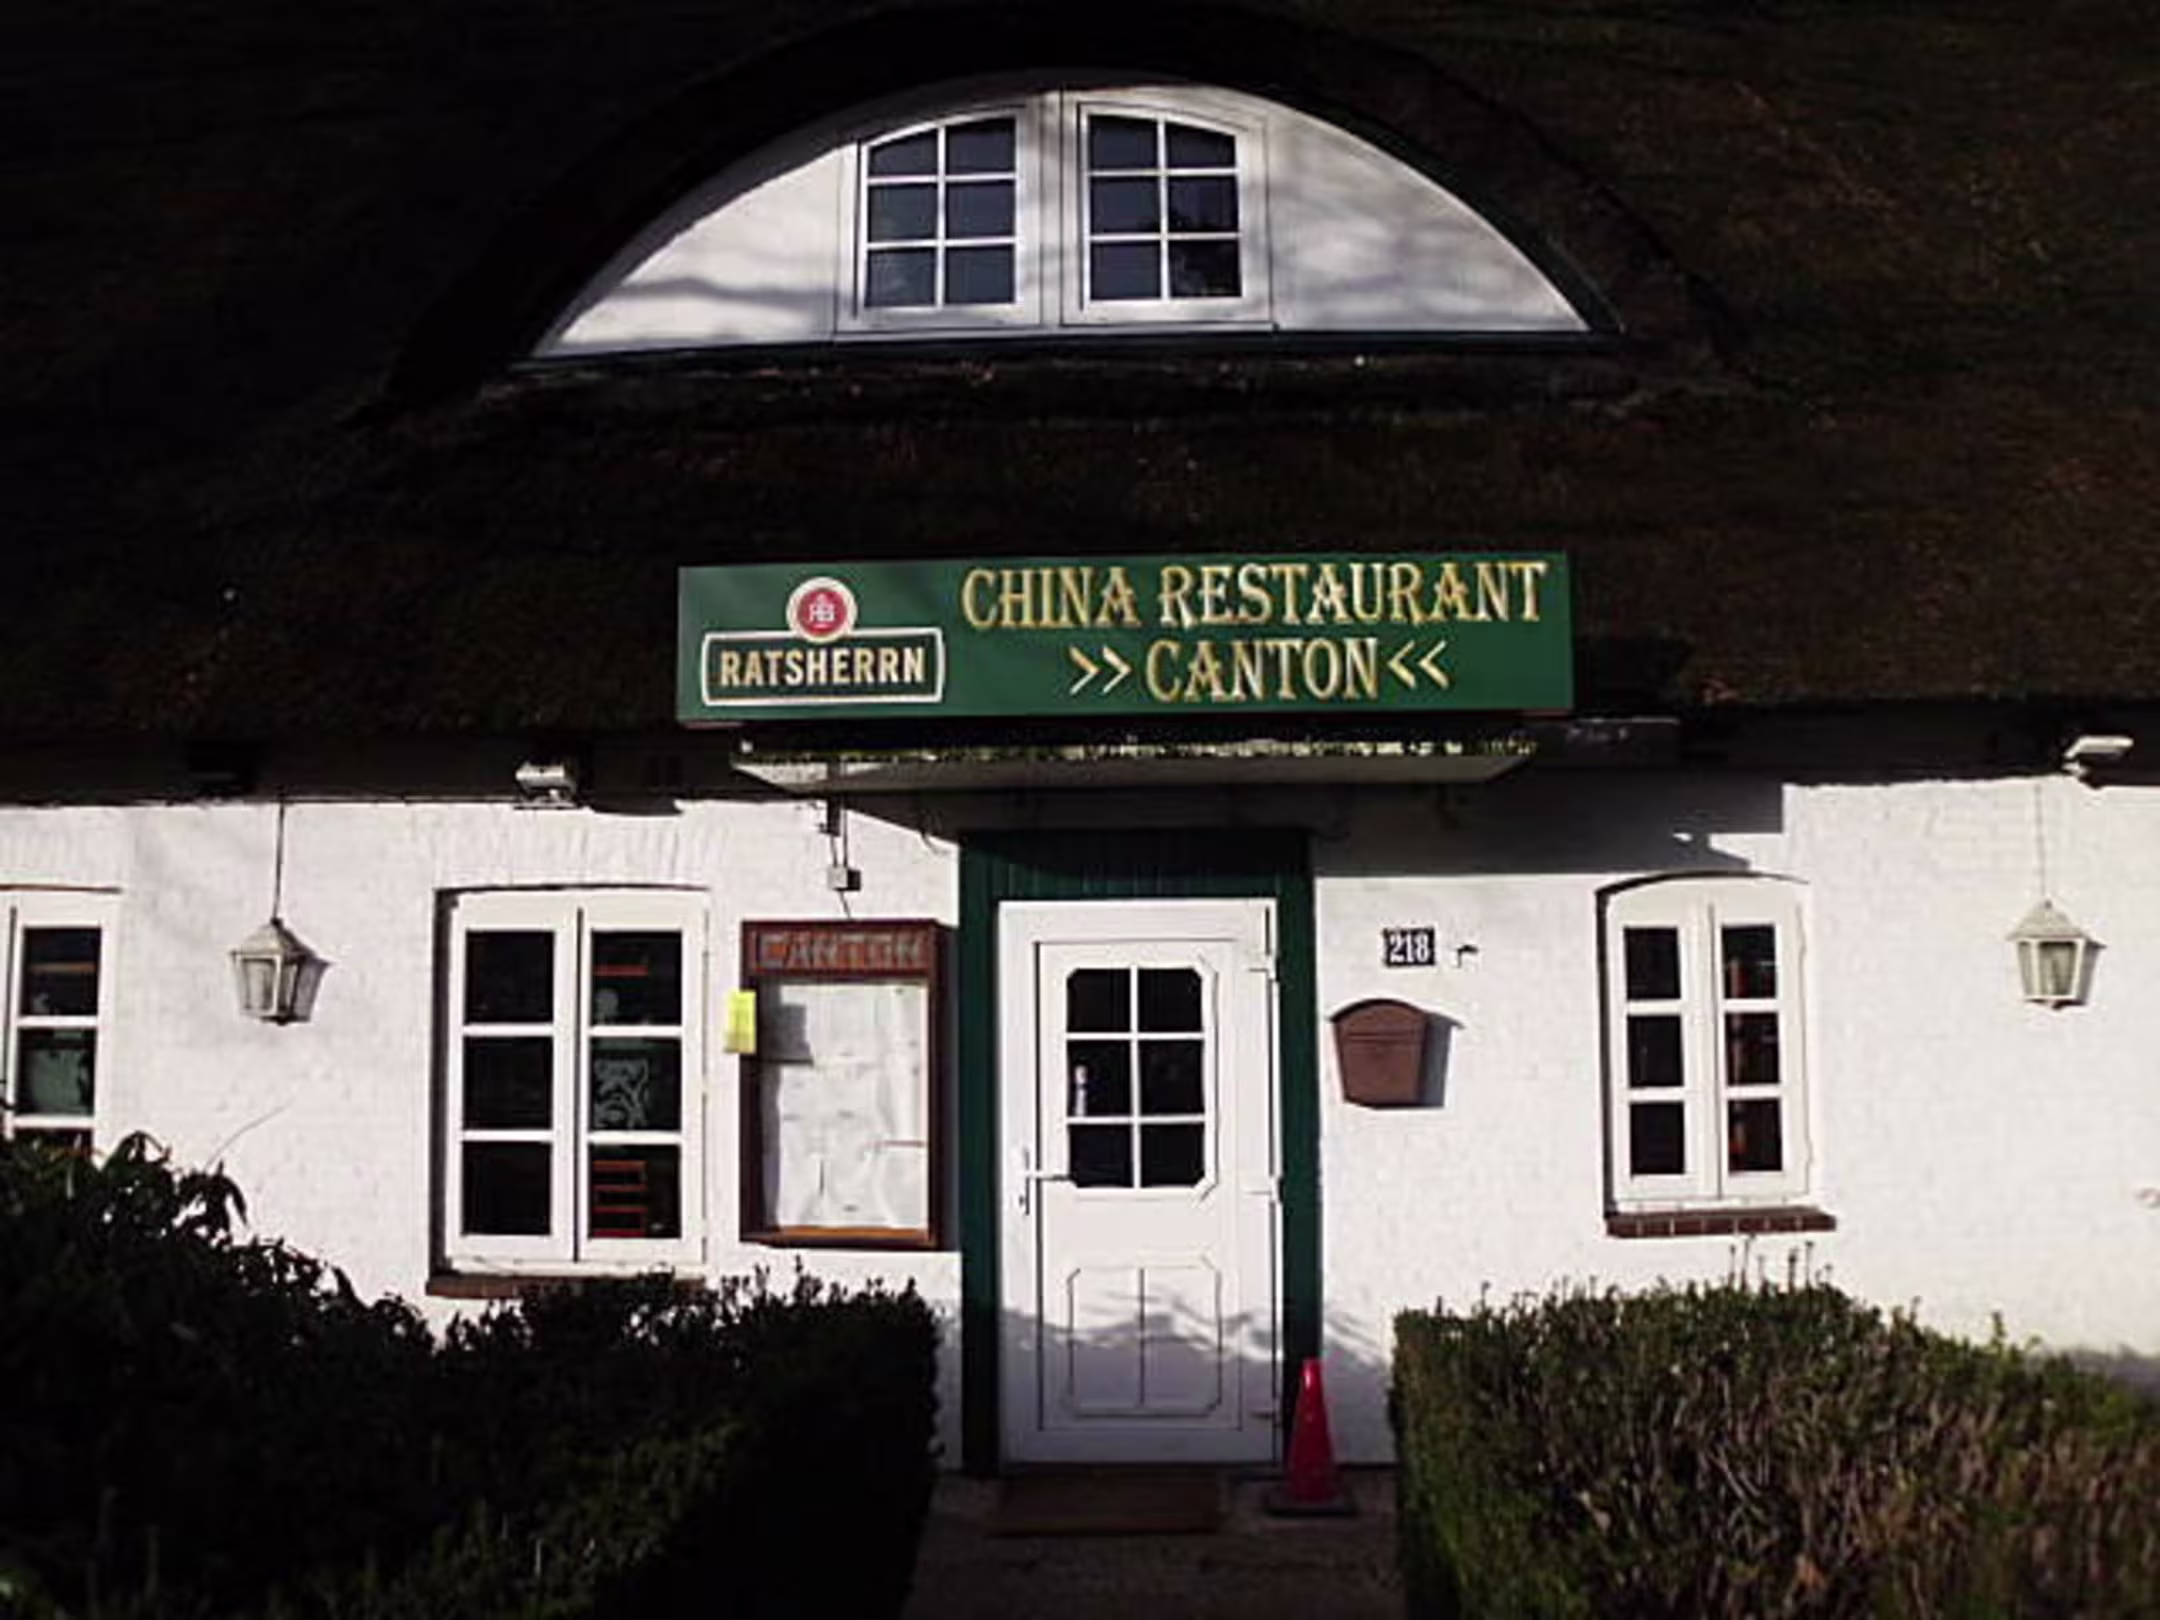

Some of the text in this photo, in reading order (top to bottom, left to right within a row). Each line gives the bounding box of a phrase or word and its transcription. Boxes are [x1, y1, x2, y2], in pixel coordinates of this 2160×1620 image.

[961, 561, 1546, 629] CHINA RESTAURANT
[720, 648, 925, 687] RATSHERRN
[1146, 637, 1379, 703] CANTON
[1390, 933, 1429, 963] 218
